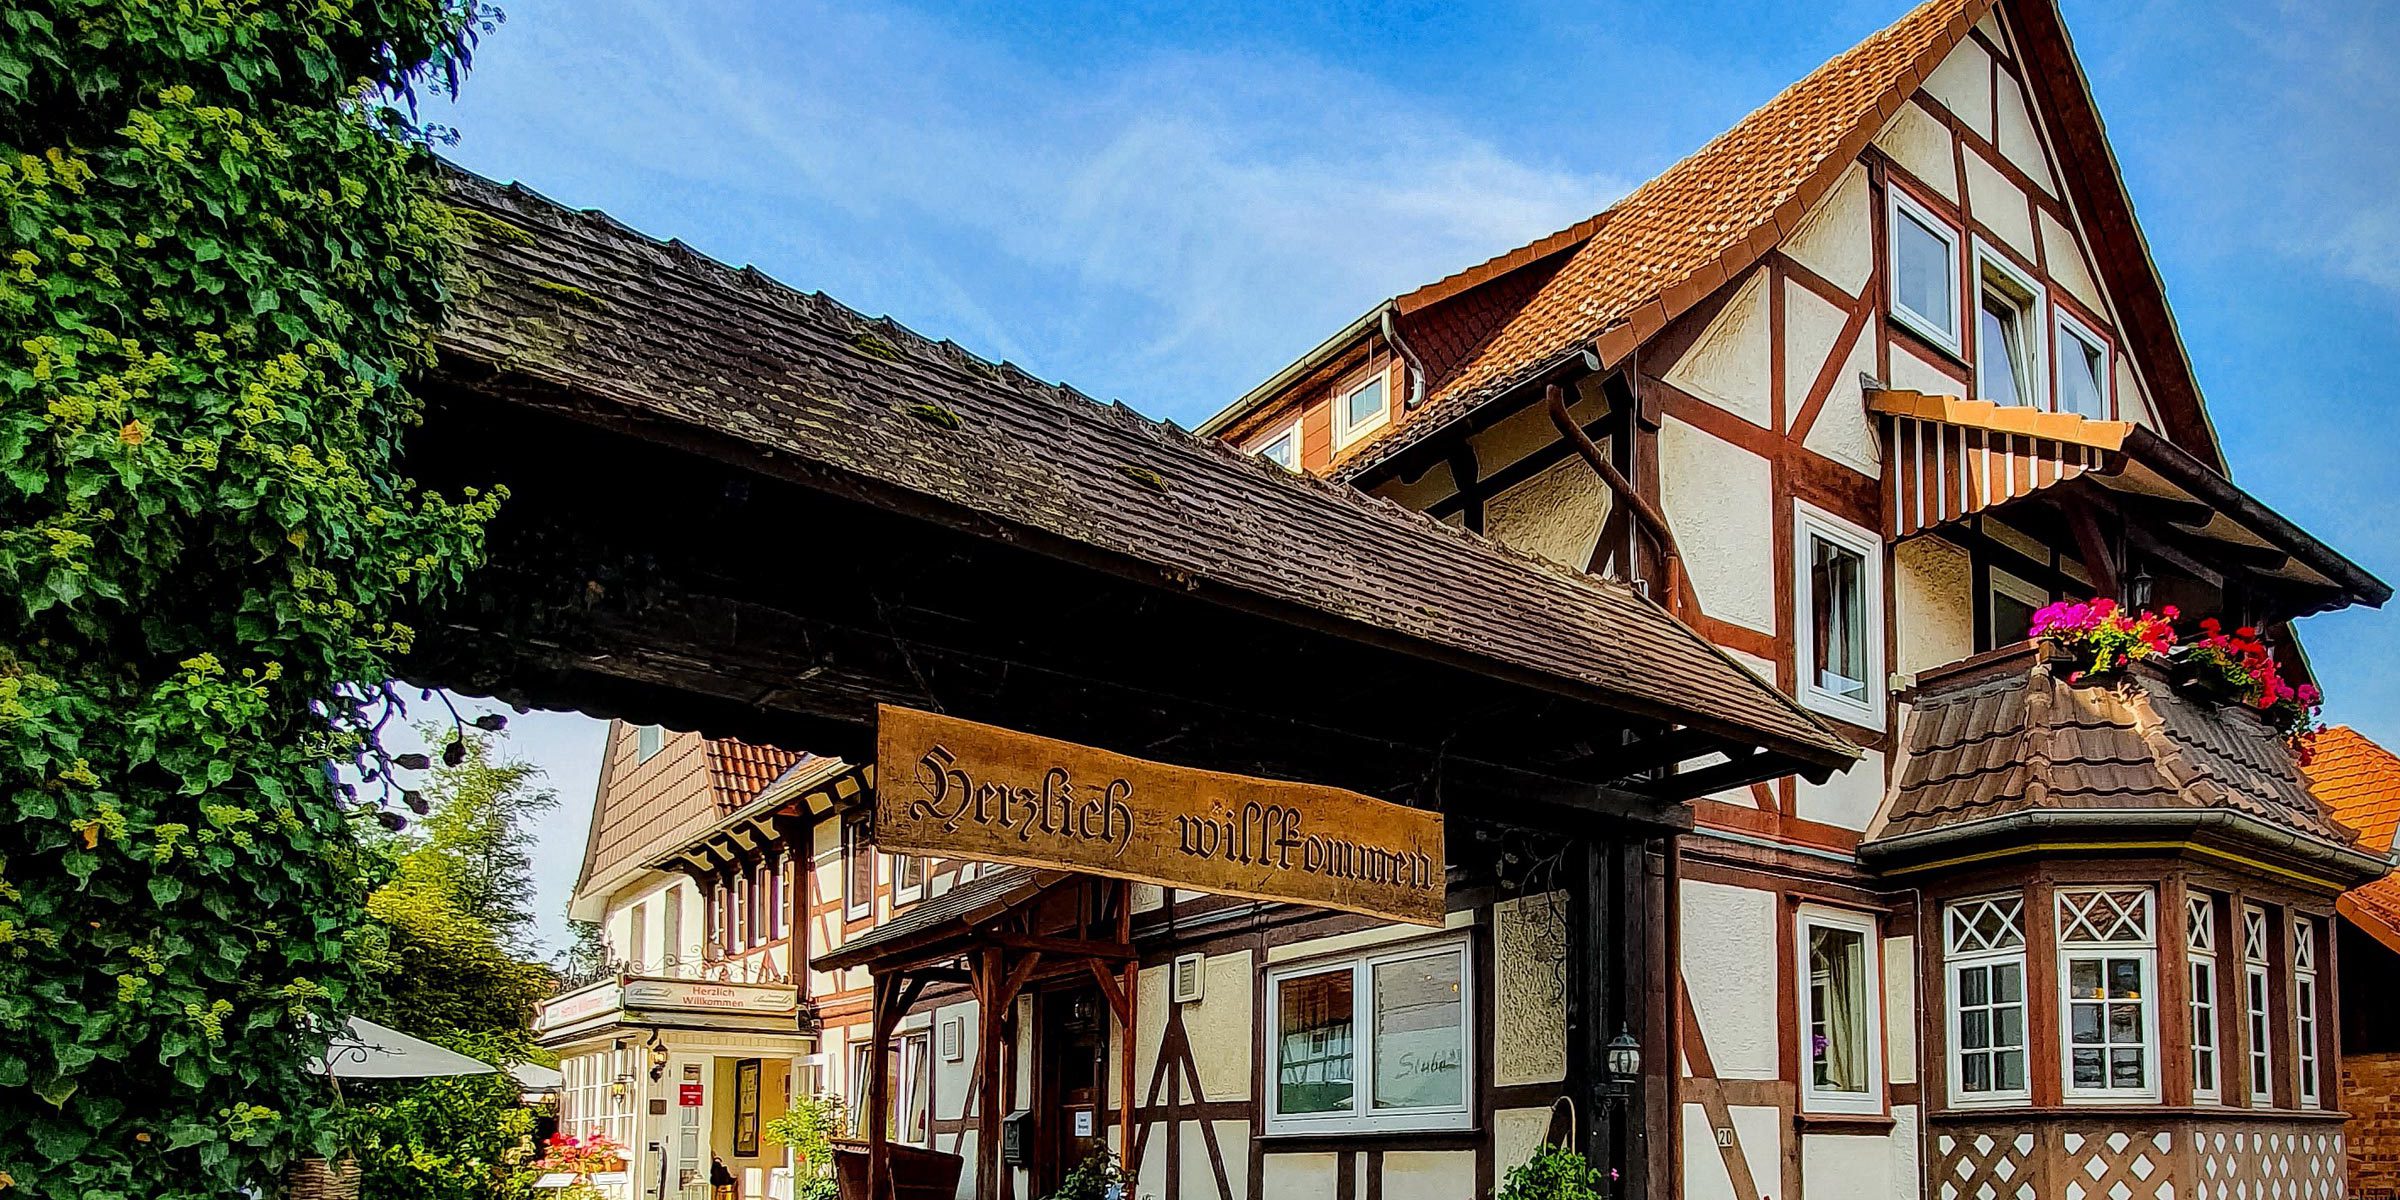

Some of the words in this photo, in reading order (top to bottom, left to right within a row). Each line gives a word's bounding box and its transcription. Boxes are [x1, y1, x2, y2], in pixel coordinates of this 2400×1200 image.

[908, 743, 1134, 858] Herzlich
[1174, 800, 1435, 891] willkommen
[692, 986, 735, 997] Herzlich
[682, 996, 744, 1008] Willkommen
[1719, 1130, 1732, 1145] 20
